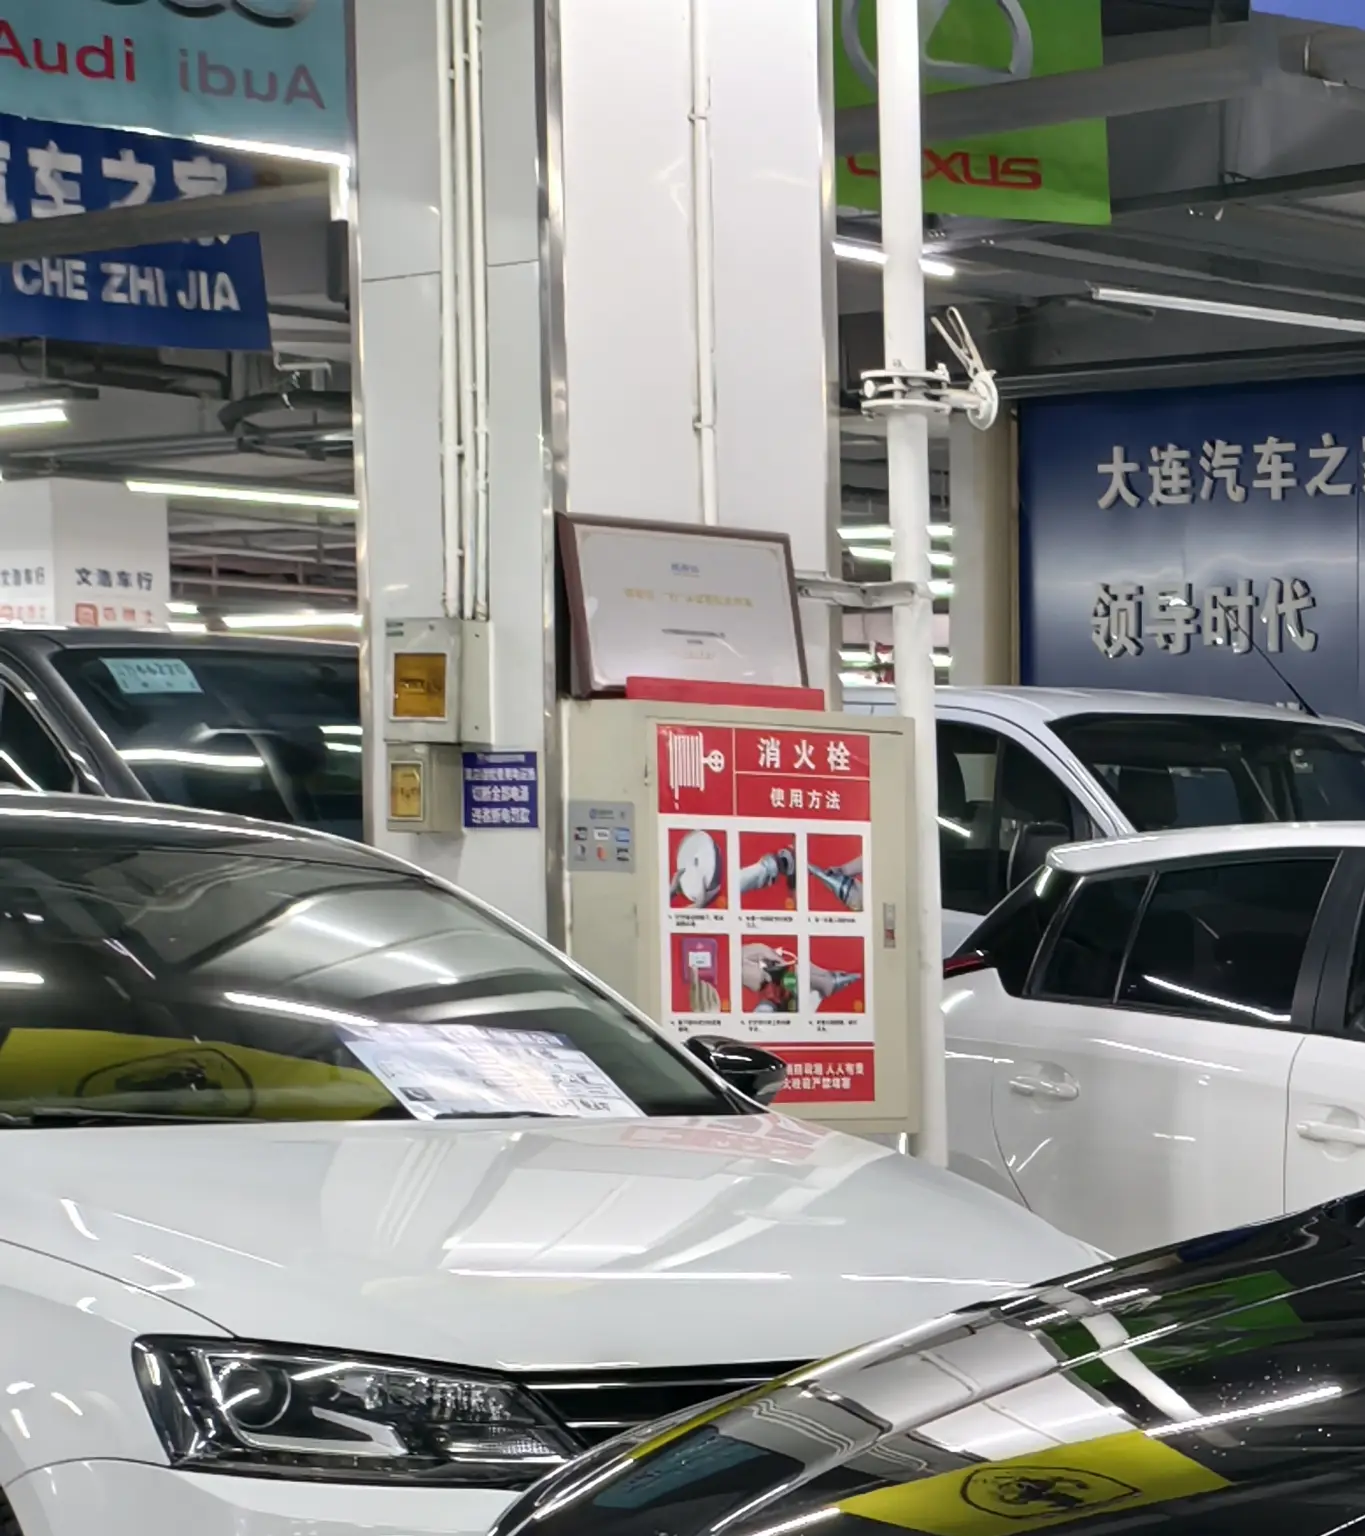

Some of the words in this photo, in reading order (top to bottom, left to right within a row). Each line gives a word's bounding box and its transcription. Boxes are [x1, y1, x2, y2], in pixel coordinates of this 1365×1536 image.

[0, 18, 137, 83] Audi
[845, 147, 1043, 191] LXUS
[12, 256, 89, 302] CHE
[100, 260, 169, 308] ZHI
[176, 270, 242, 312] JIA
[1090, 577, 1319, 660] 领导时代
[757, 736, 851, 772] 消火栓
[769, 787, 842, 811] 使用方法
